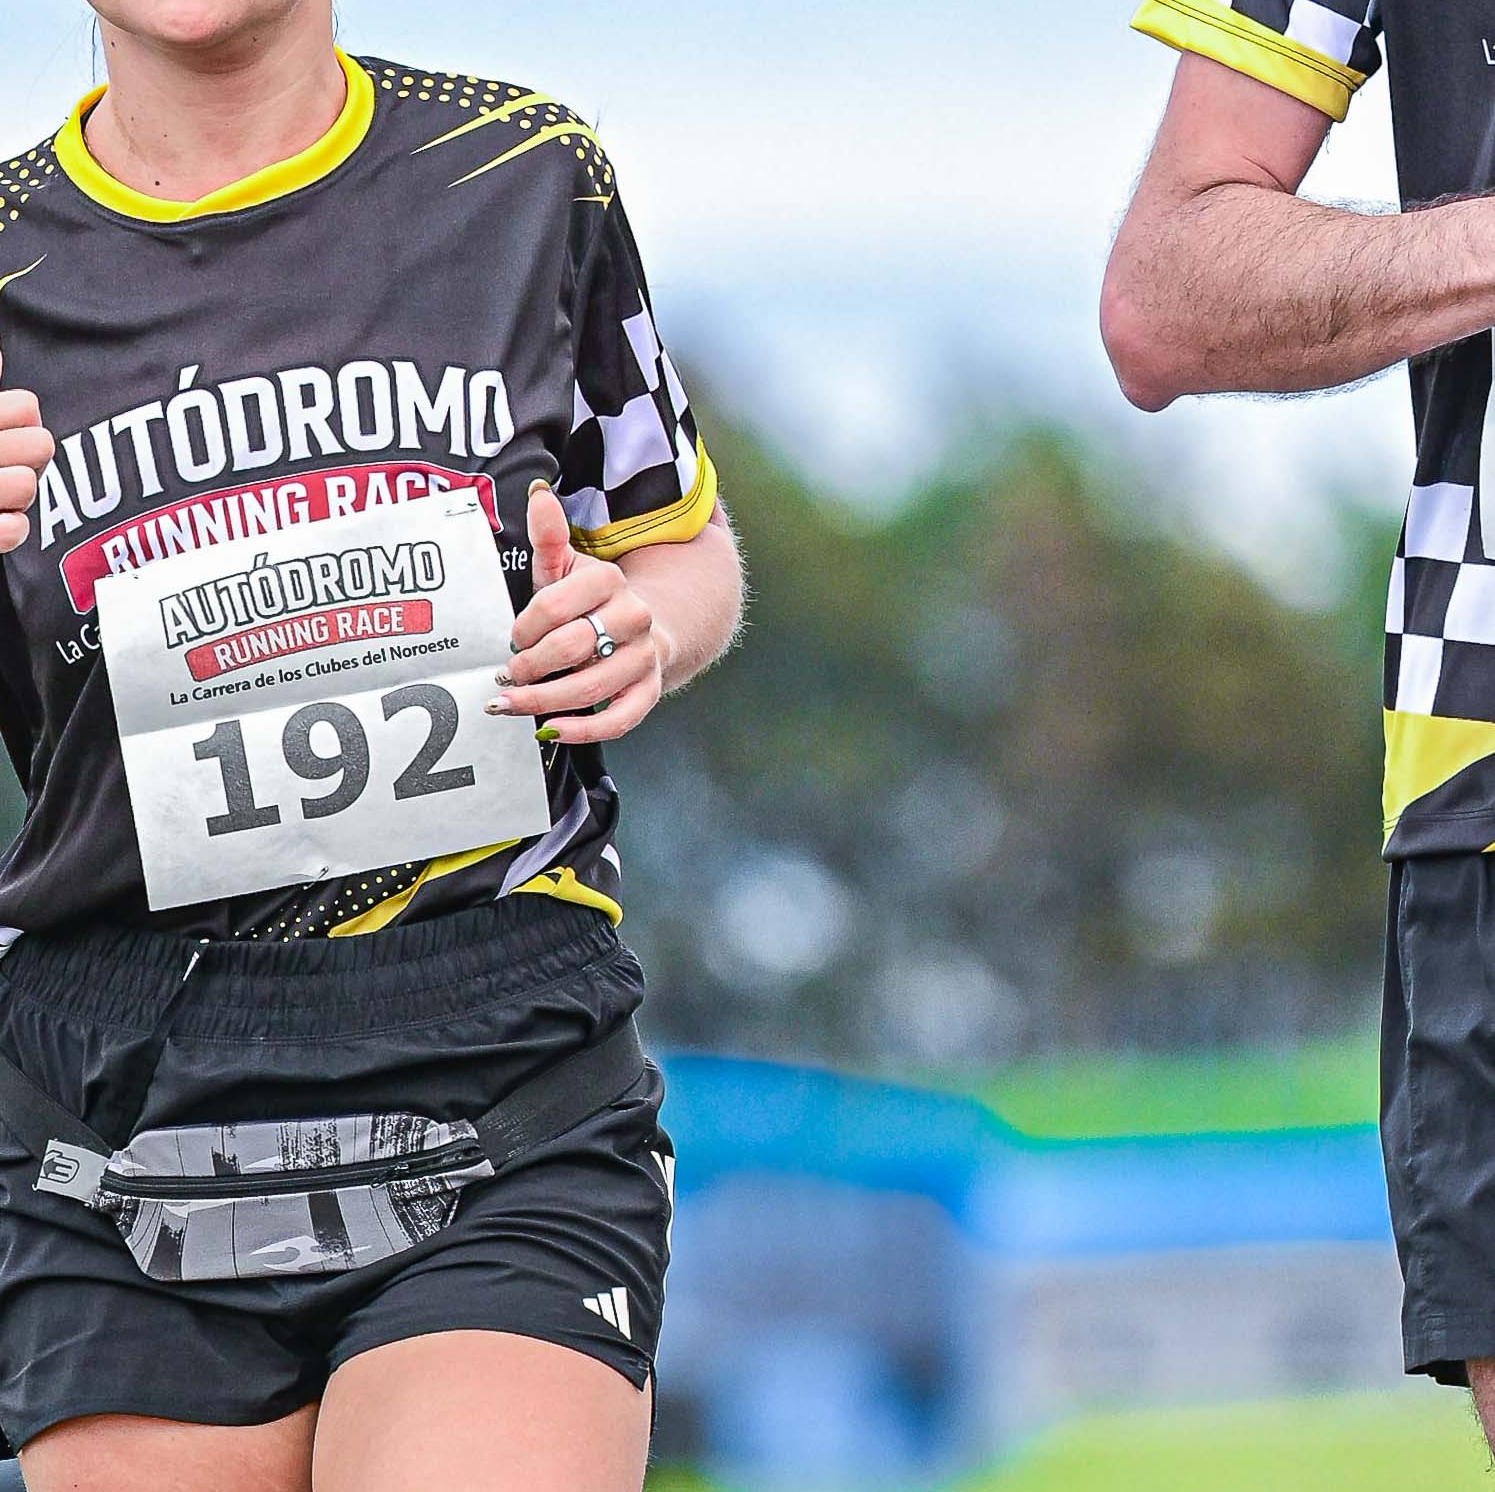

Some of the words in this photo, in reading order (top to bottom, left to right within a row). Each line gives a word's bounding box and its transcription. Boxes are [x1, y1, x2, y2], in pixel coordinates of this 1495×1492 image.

[38, 359, 515, 552] AUTÓDROMO
[100, 482, 310, 574] RUNNING
[55, 640, 84, 664] La
[502, 546, 528, 571] ste
[159, 541, 446, 649] AUTÓDROMO
[213, 618, 330, 670] RUNNING
[336, 606, 405, 638] RACE
[170, 692, 188, 705] La
[192, 680, 251, 701] Carrera
[254, 673, 275, 687] de
[278, 668, 303, 683] los
[305, 658, 359, 677] Clubes
[362, 648, 387, 666] del
[390, 637, 460, 661] Noroeste
[192, 683, 476, 837] 192
